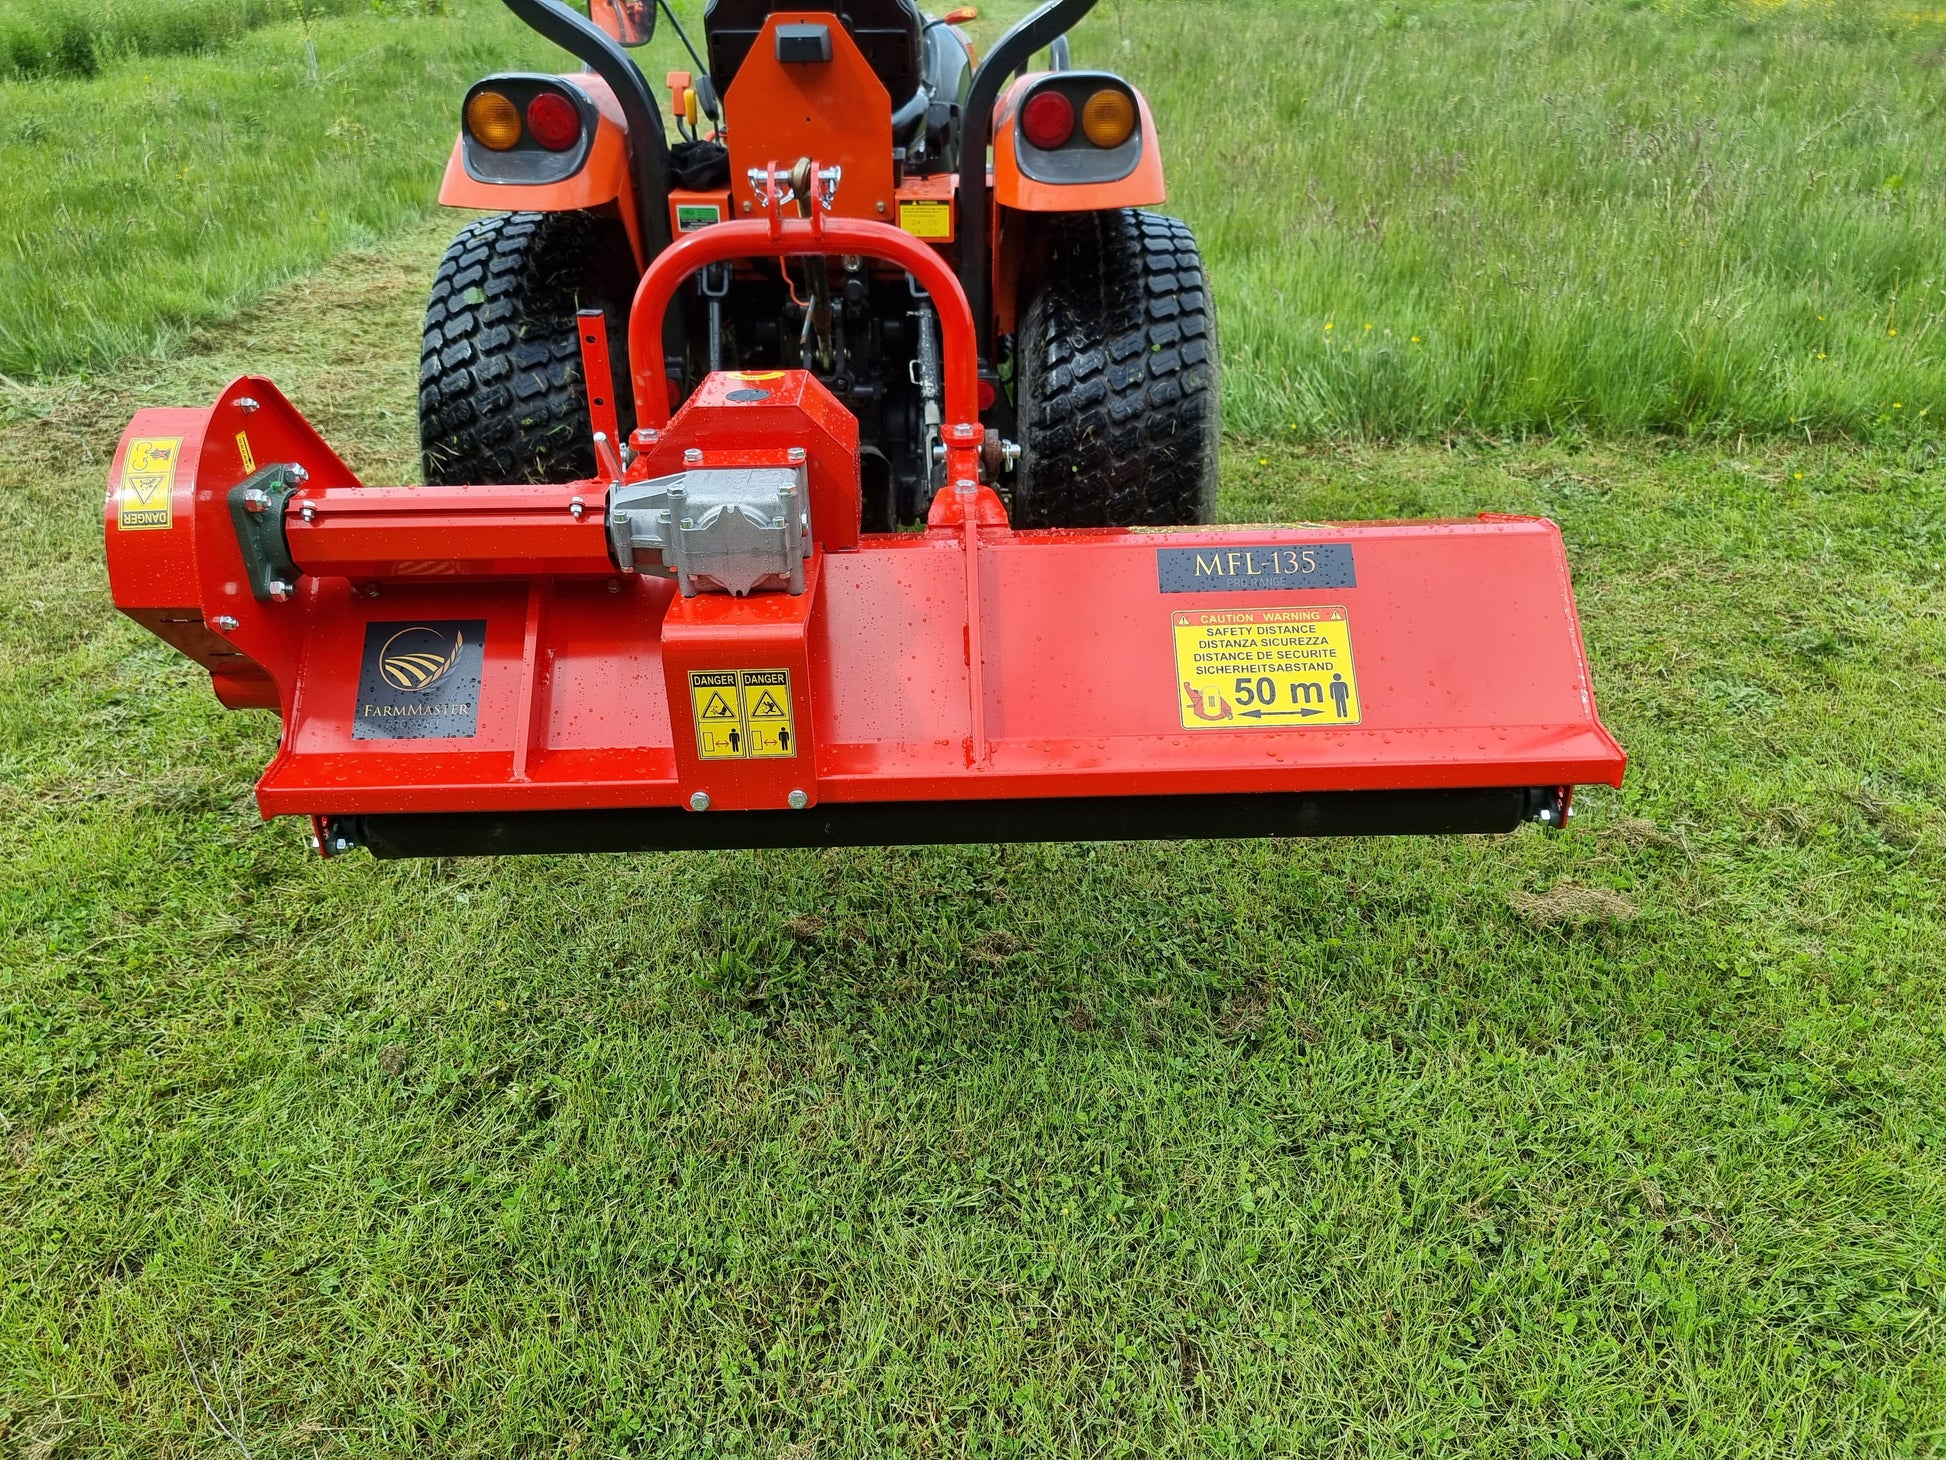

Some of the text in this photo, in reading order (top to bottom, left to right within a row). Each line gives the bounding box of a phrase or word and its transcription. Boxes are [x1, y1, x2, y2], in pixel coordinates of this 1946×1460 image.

[123, 512, 167, 525] DANGER
[1193, 550, 1317, 577] MFL-135
[1226, 576, 1287, 588] PRO RANGE
[1200, 611, 1321, 624] CAUTION WARNING
[1206, 624, 1317, 637] SAFETY DISTANCE
[1198, 636, 1329, 649] DISTANZA SICUREZZA
[1193, 649, 1338, 662] DISTANCE DE SECURITE
[1195, 662, 1334, 675] SICHERHEITSABSTAND
[693, 675, 735, 685] DANGER
[744, 674, 785, 684] DANGER
[1234, 676, 1324, 706] 50 m
